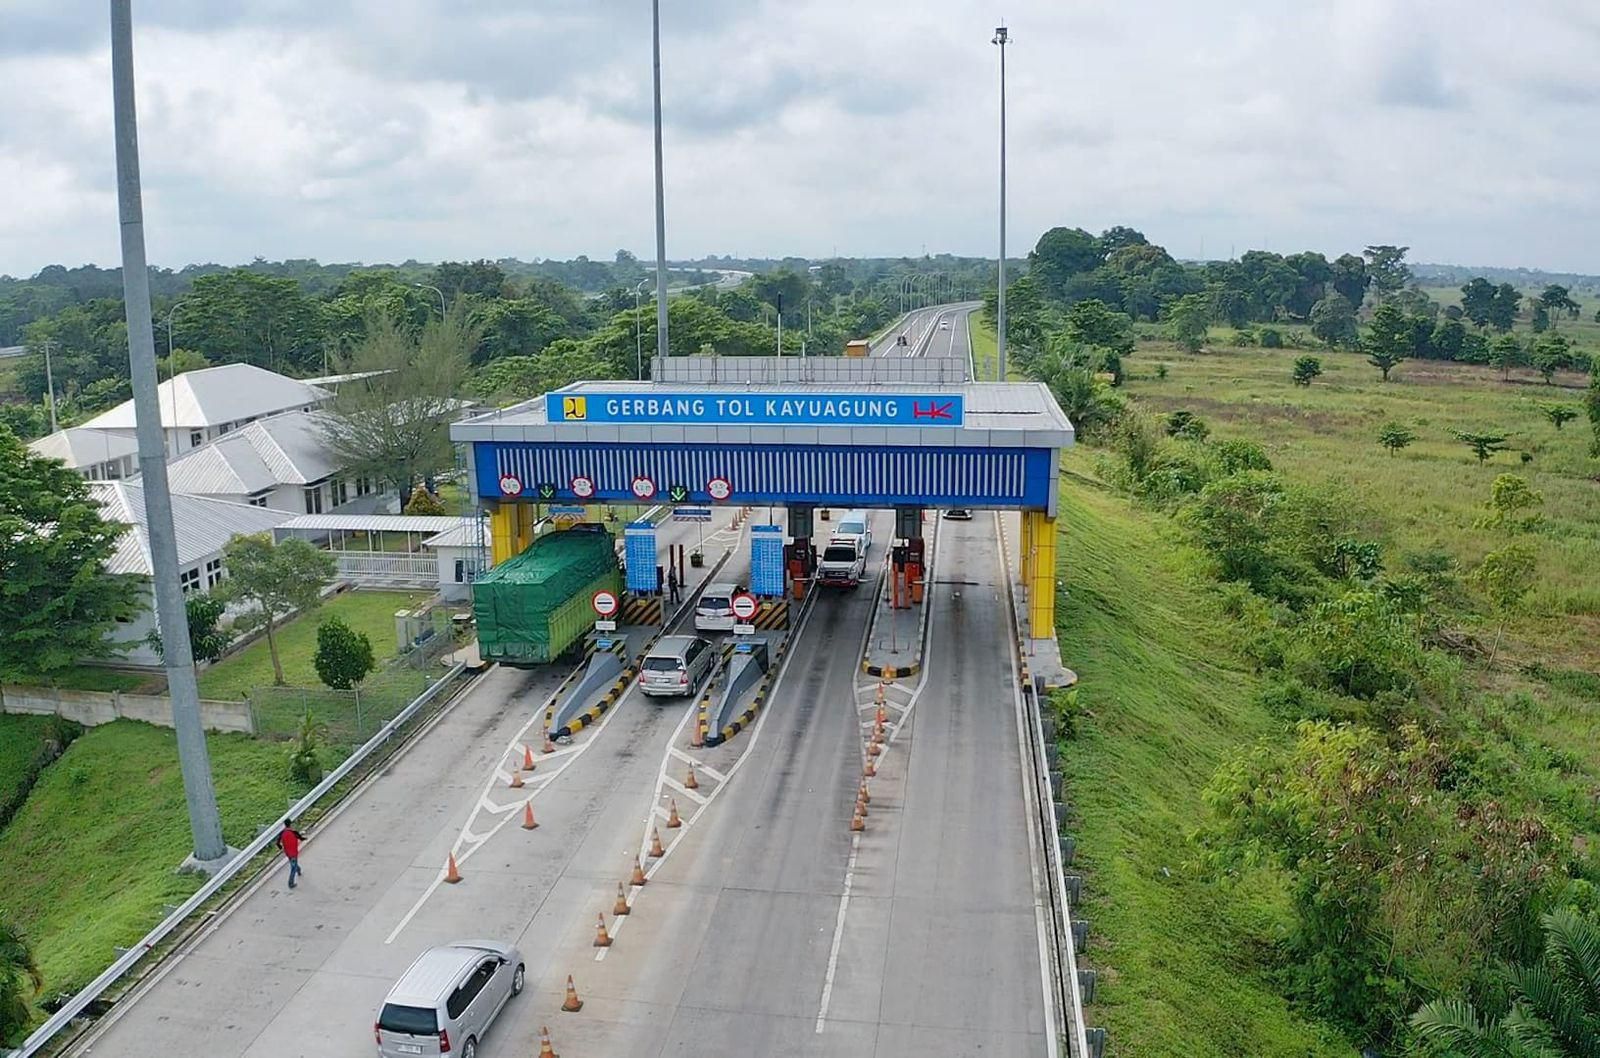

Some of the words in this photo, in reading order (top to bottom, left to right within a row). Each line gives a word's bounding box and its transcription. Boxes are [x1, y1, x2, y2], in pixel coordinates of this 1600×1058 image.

[606, 399, 705, 416] GERBANG
[716, 400, 754, 416] TOL
[765, 400, 898, 417] KAYUAGUNG
[913, 401, 953, 419] HK
